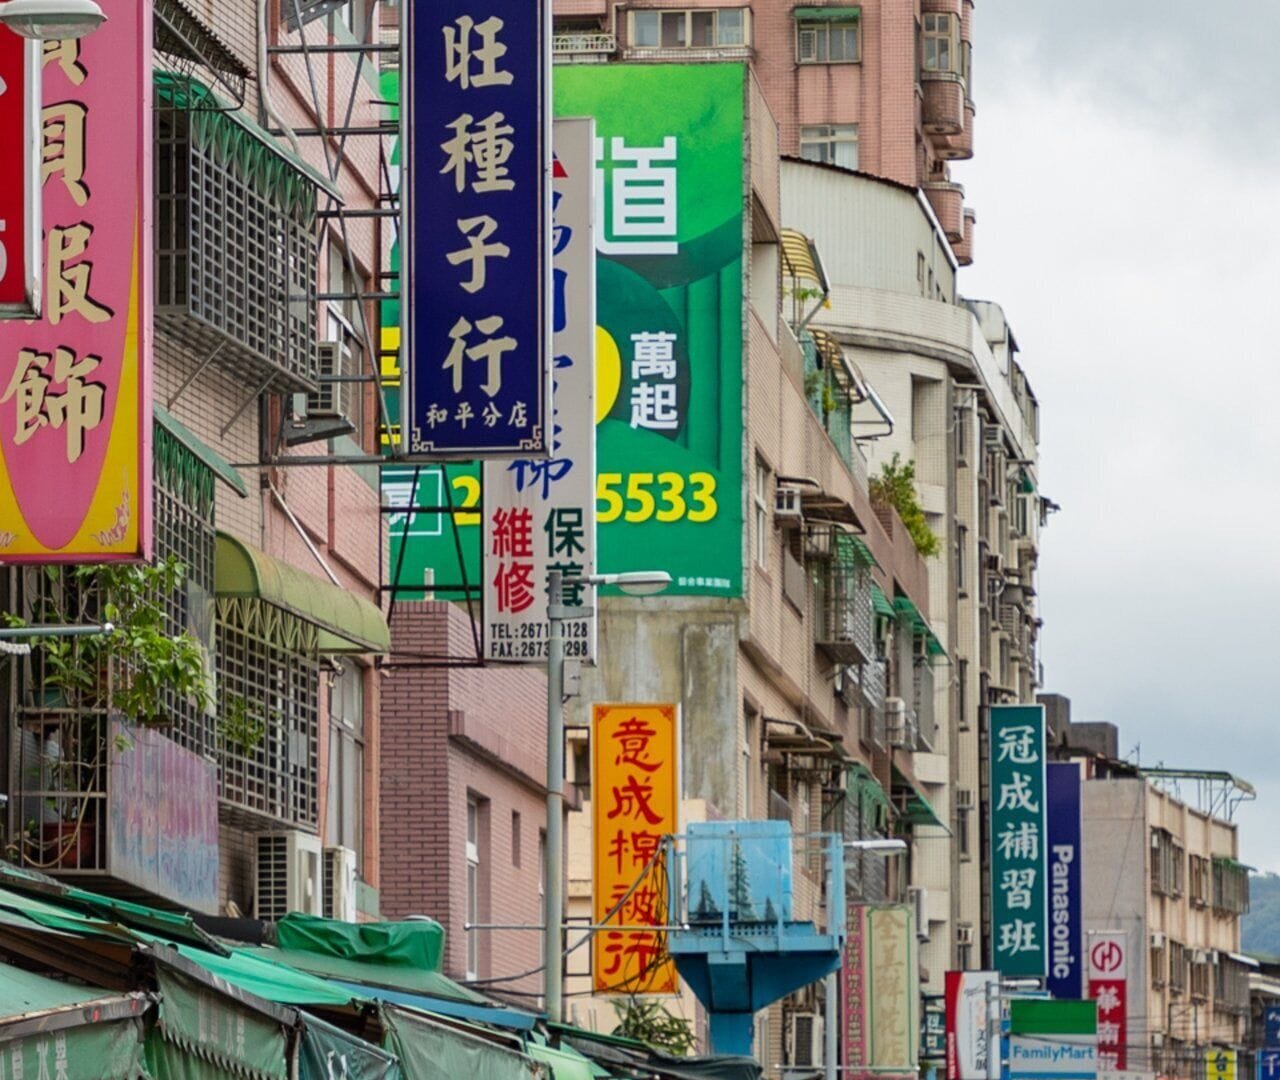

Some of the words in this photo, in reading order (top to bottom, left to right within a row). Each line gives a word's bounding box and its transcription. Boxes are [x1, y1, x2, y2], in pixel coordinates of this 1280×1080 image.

[439, 14, 518, 399] 旺種子行
[426, 402, 528, 429] 和平分店
[630, 331, 679, 430] 萬起
[491, 506, 533, 614] 維修
[996, 724, 1041, 957] 冠成補習班
[1051, 844, 1075, 979] Panasonic
[1012, 1044, 1095, 1064] FamilyMart
